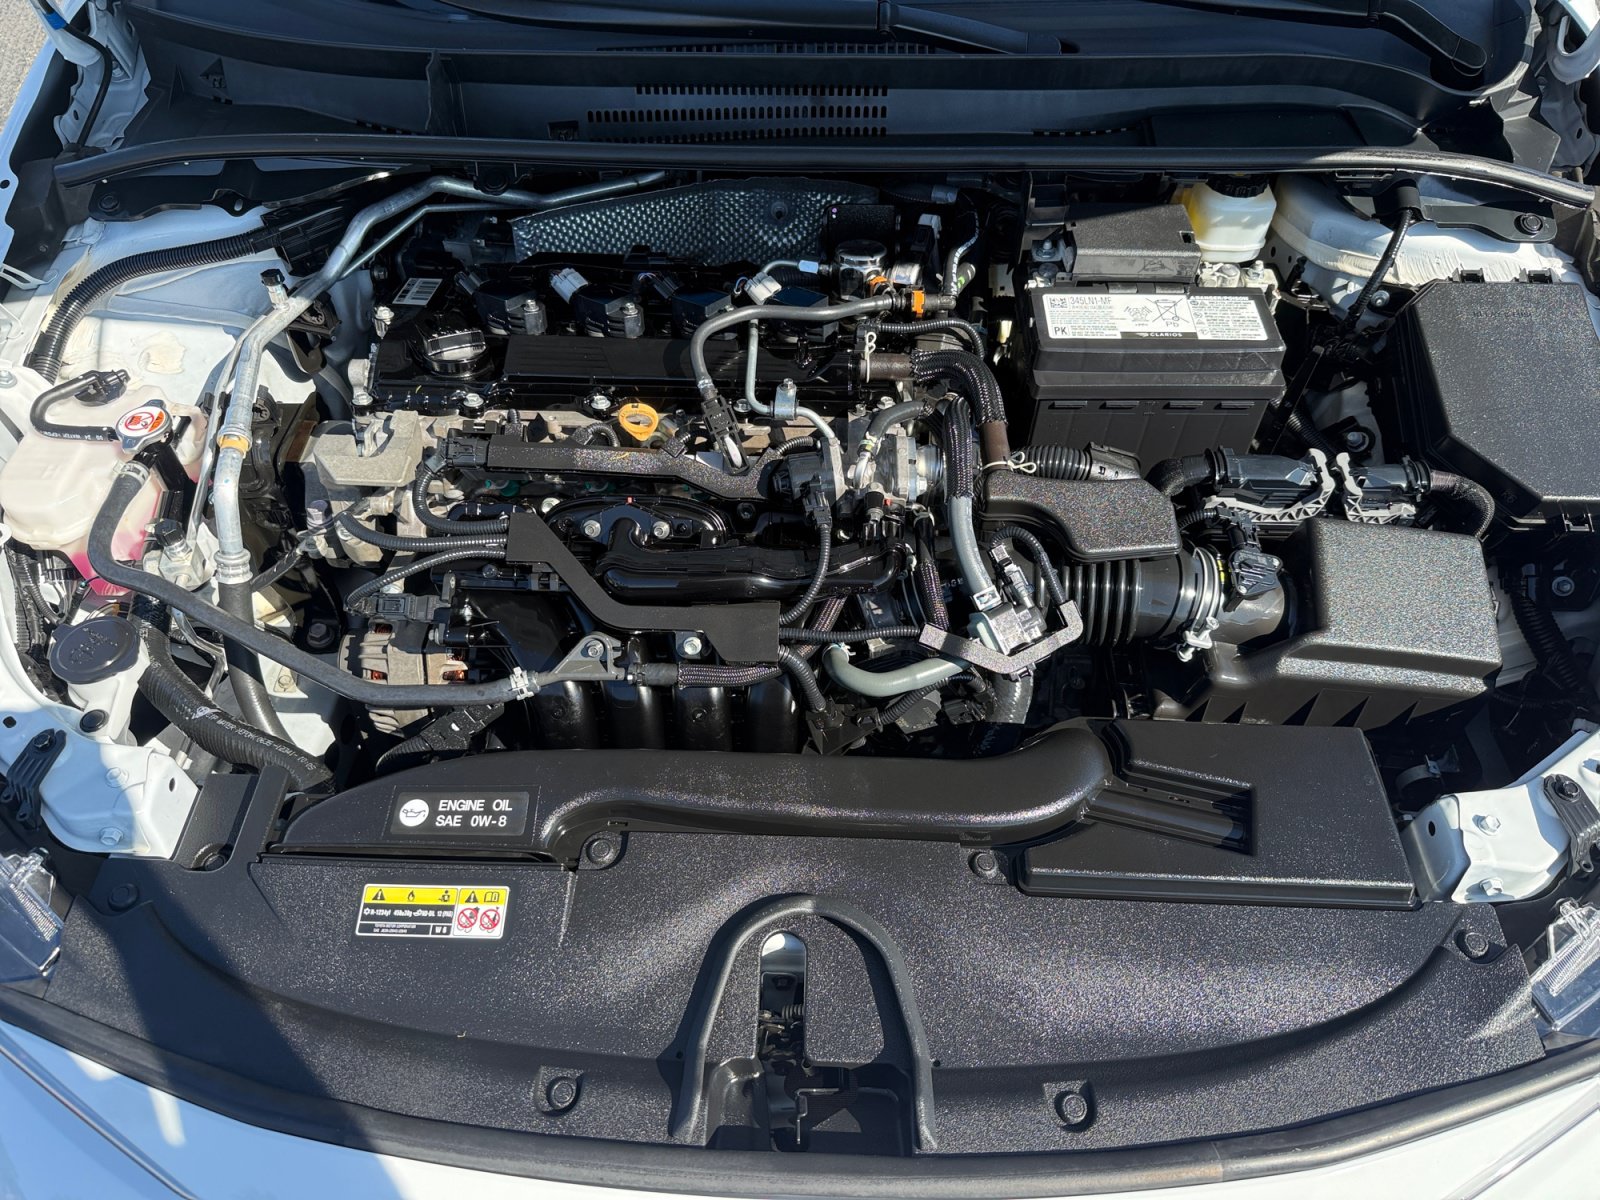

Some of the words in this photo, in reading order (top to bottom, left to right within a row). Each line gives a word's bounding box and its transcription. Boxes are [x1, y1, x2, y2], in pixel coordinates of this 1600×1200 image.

[1070, 296, 1112, 305] 345LN1-MF
[1054, 326, 1068, 336] PK
[438, 799, 486, 812] ENGINE
[492, 799, 513, 812] OIL
[435, 814, 463, 828] SAE
[470, 814, 508, 828] 0W-8
[435, 926, 441, 934] W
